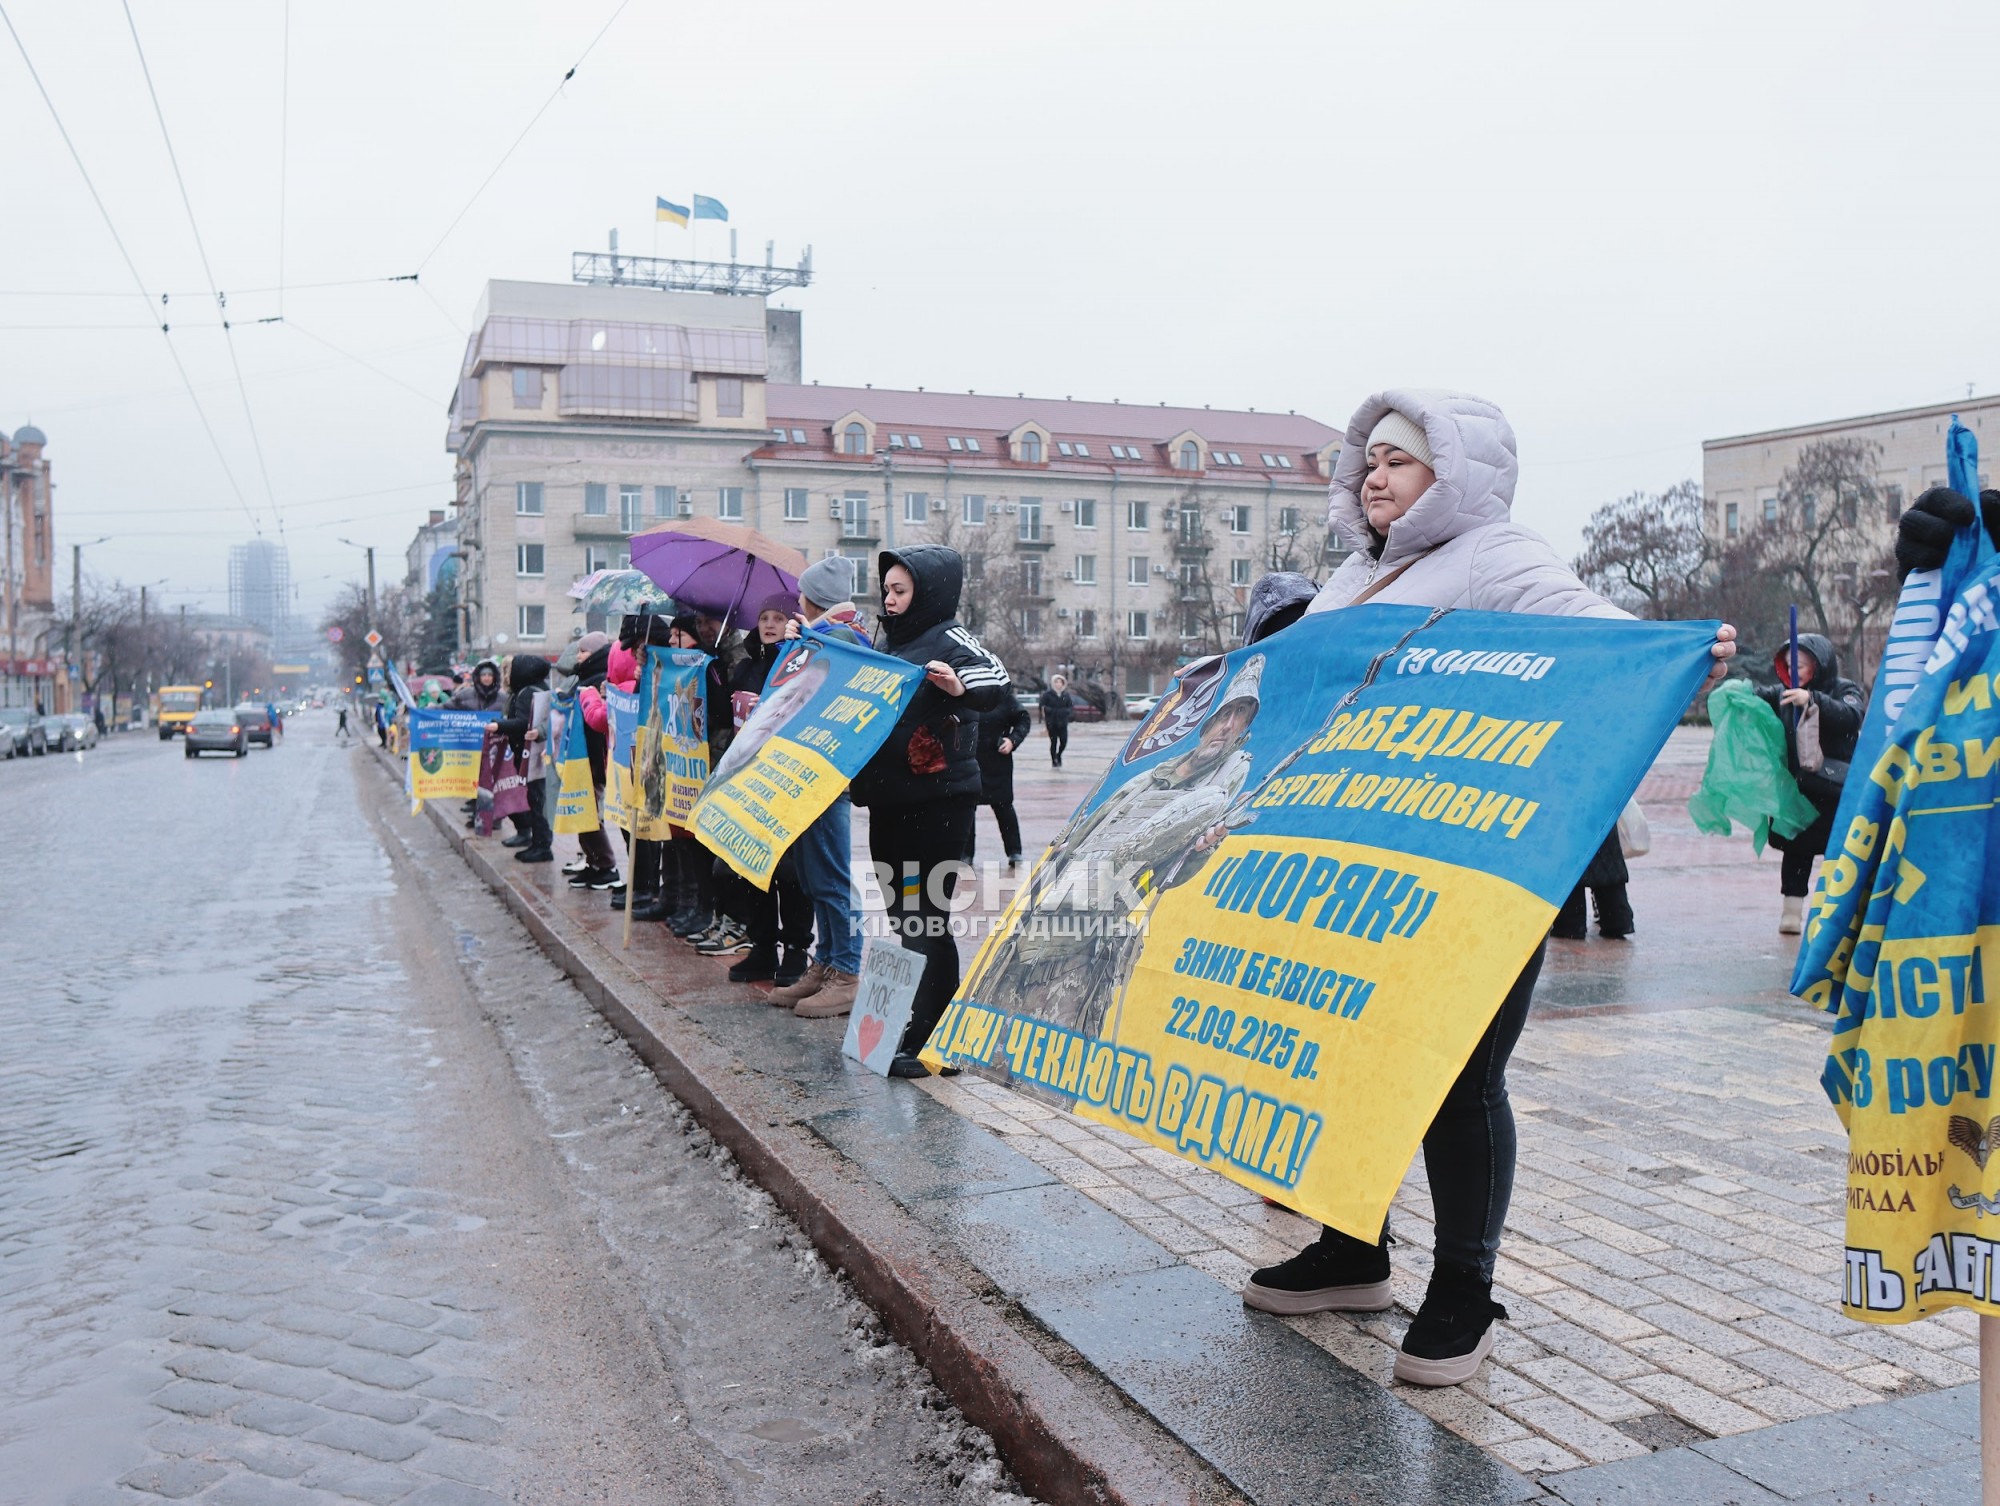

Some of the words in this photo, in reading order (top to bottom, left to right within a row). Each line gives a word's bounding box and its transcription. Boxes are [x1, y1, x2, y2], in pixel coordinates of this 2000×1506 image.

[1396, 647, 1438, 675] 79
[1431, 649, 1557, 681] ОДШБр
[1252, 767, 1351, 808] СЕРГІЙ
[1334, 772, 1541, 840] ЮРІЙОВИЧ
[715, 820, 771, 874] КОХАНИЙ!
[1203, 849, 1439, 944] «МОРЯК»
[866, 982, 896, 1018] МОЄ
[1174, 937, 1246, 986] ЗНИК
[1238, 951, 1377, 1021] БЕЗВІСТИ
[1290, 1040, 1321, 1080] р.
[1005, 1018, 1154, 1120] ЧЕКАЮТЬ
[1158, 1068, 1320, 1185] ВДОМА!
